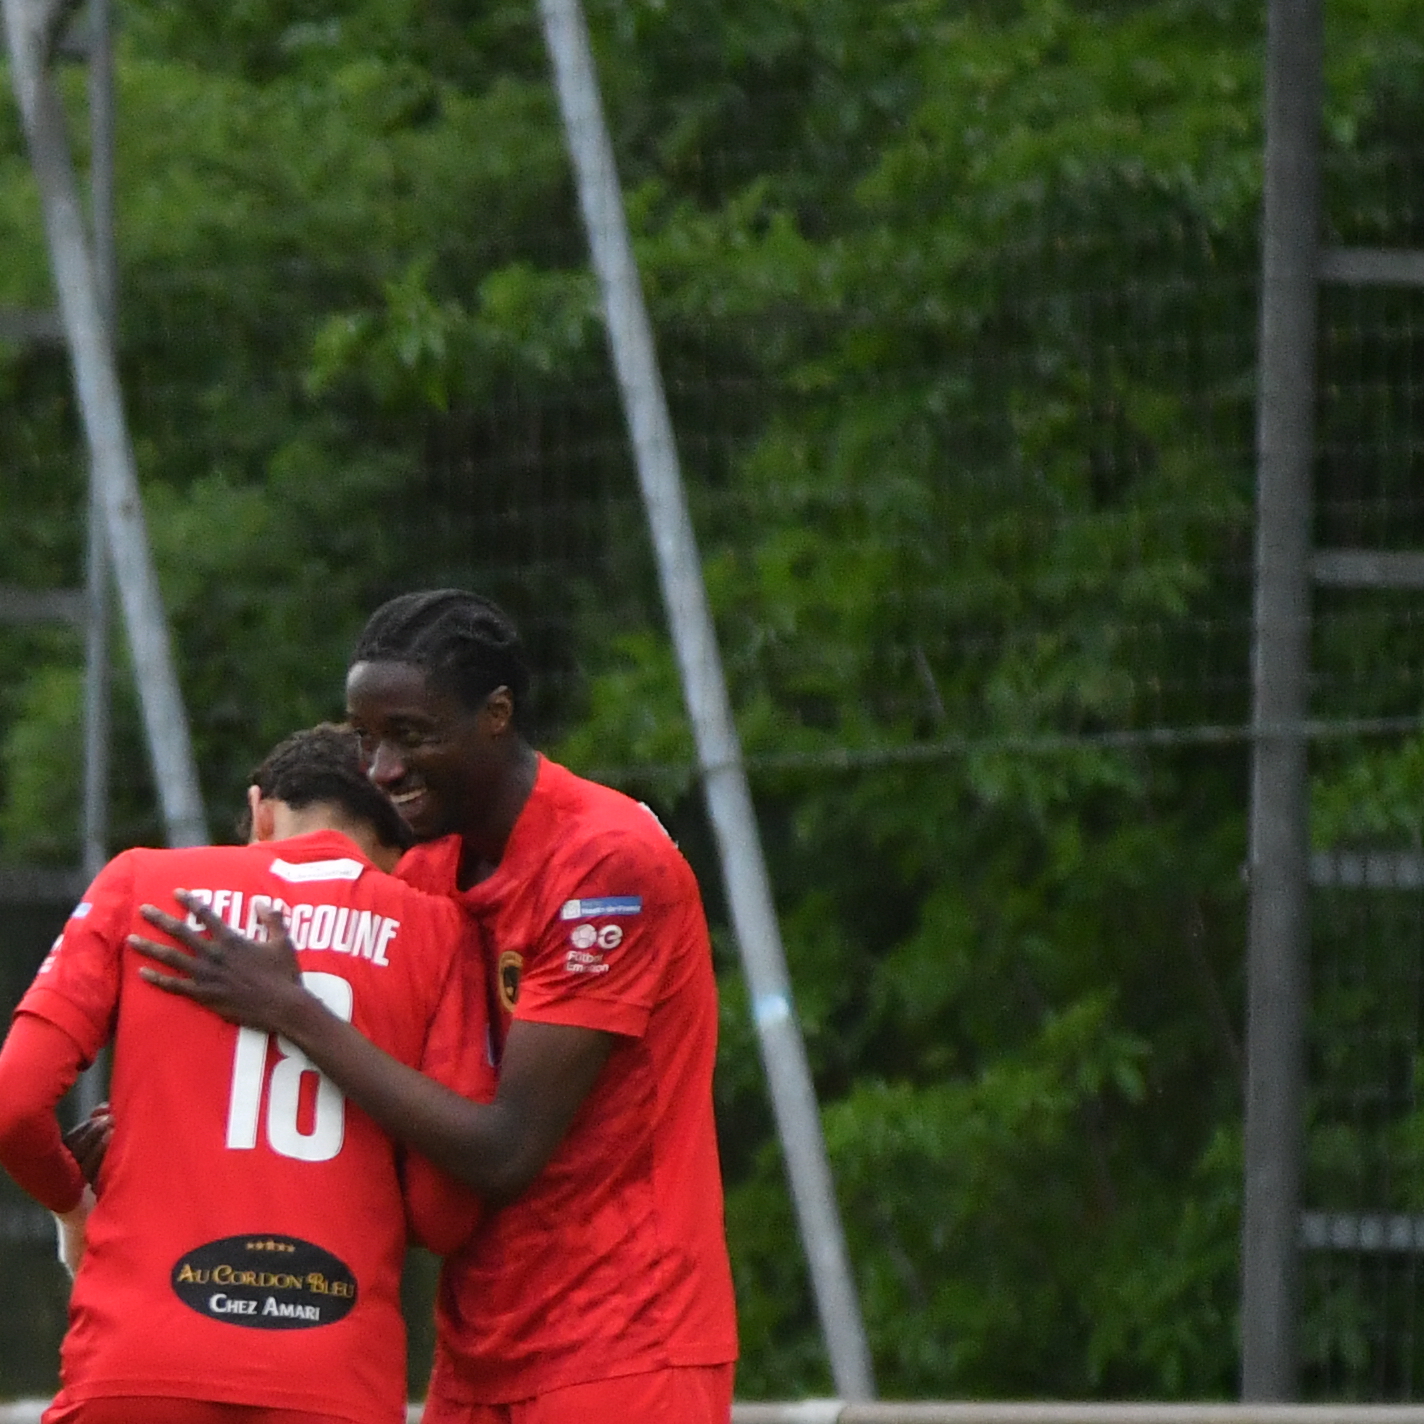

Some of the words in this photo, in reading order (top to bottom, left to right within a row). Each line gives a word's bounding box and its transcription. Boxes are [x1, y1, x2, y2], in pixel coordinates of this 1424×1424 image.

[225, 971, 353, 1162] 18
[212, 1264, 303, 1290] CORDON
[307, 1271, 355, 1299] BLEU
[209, 1293, 258, 1315] CHEZ
[261, 1296, 321, 1321] AMARI
